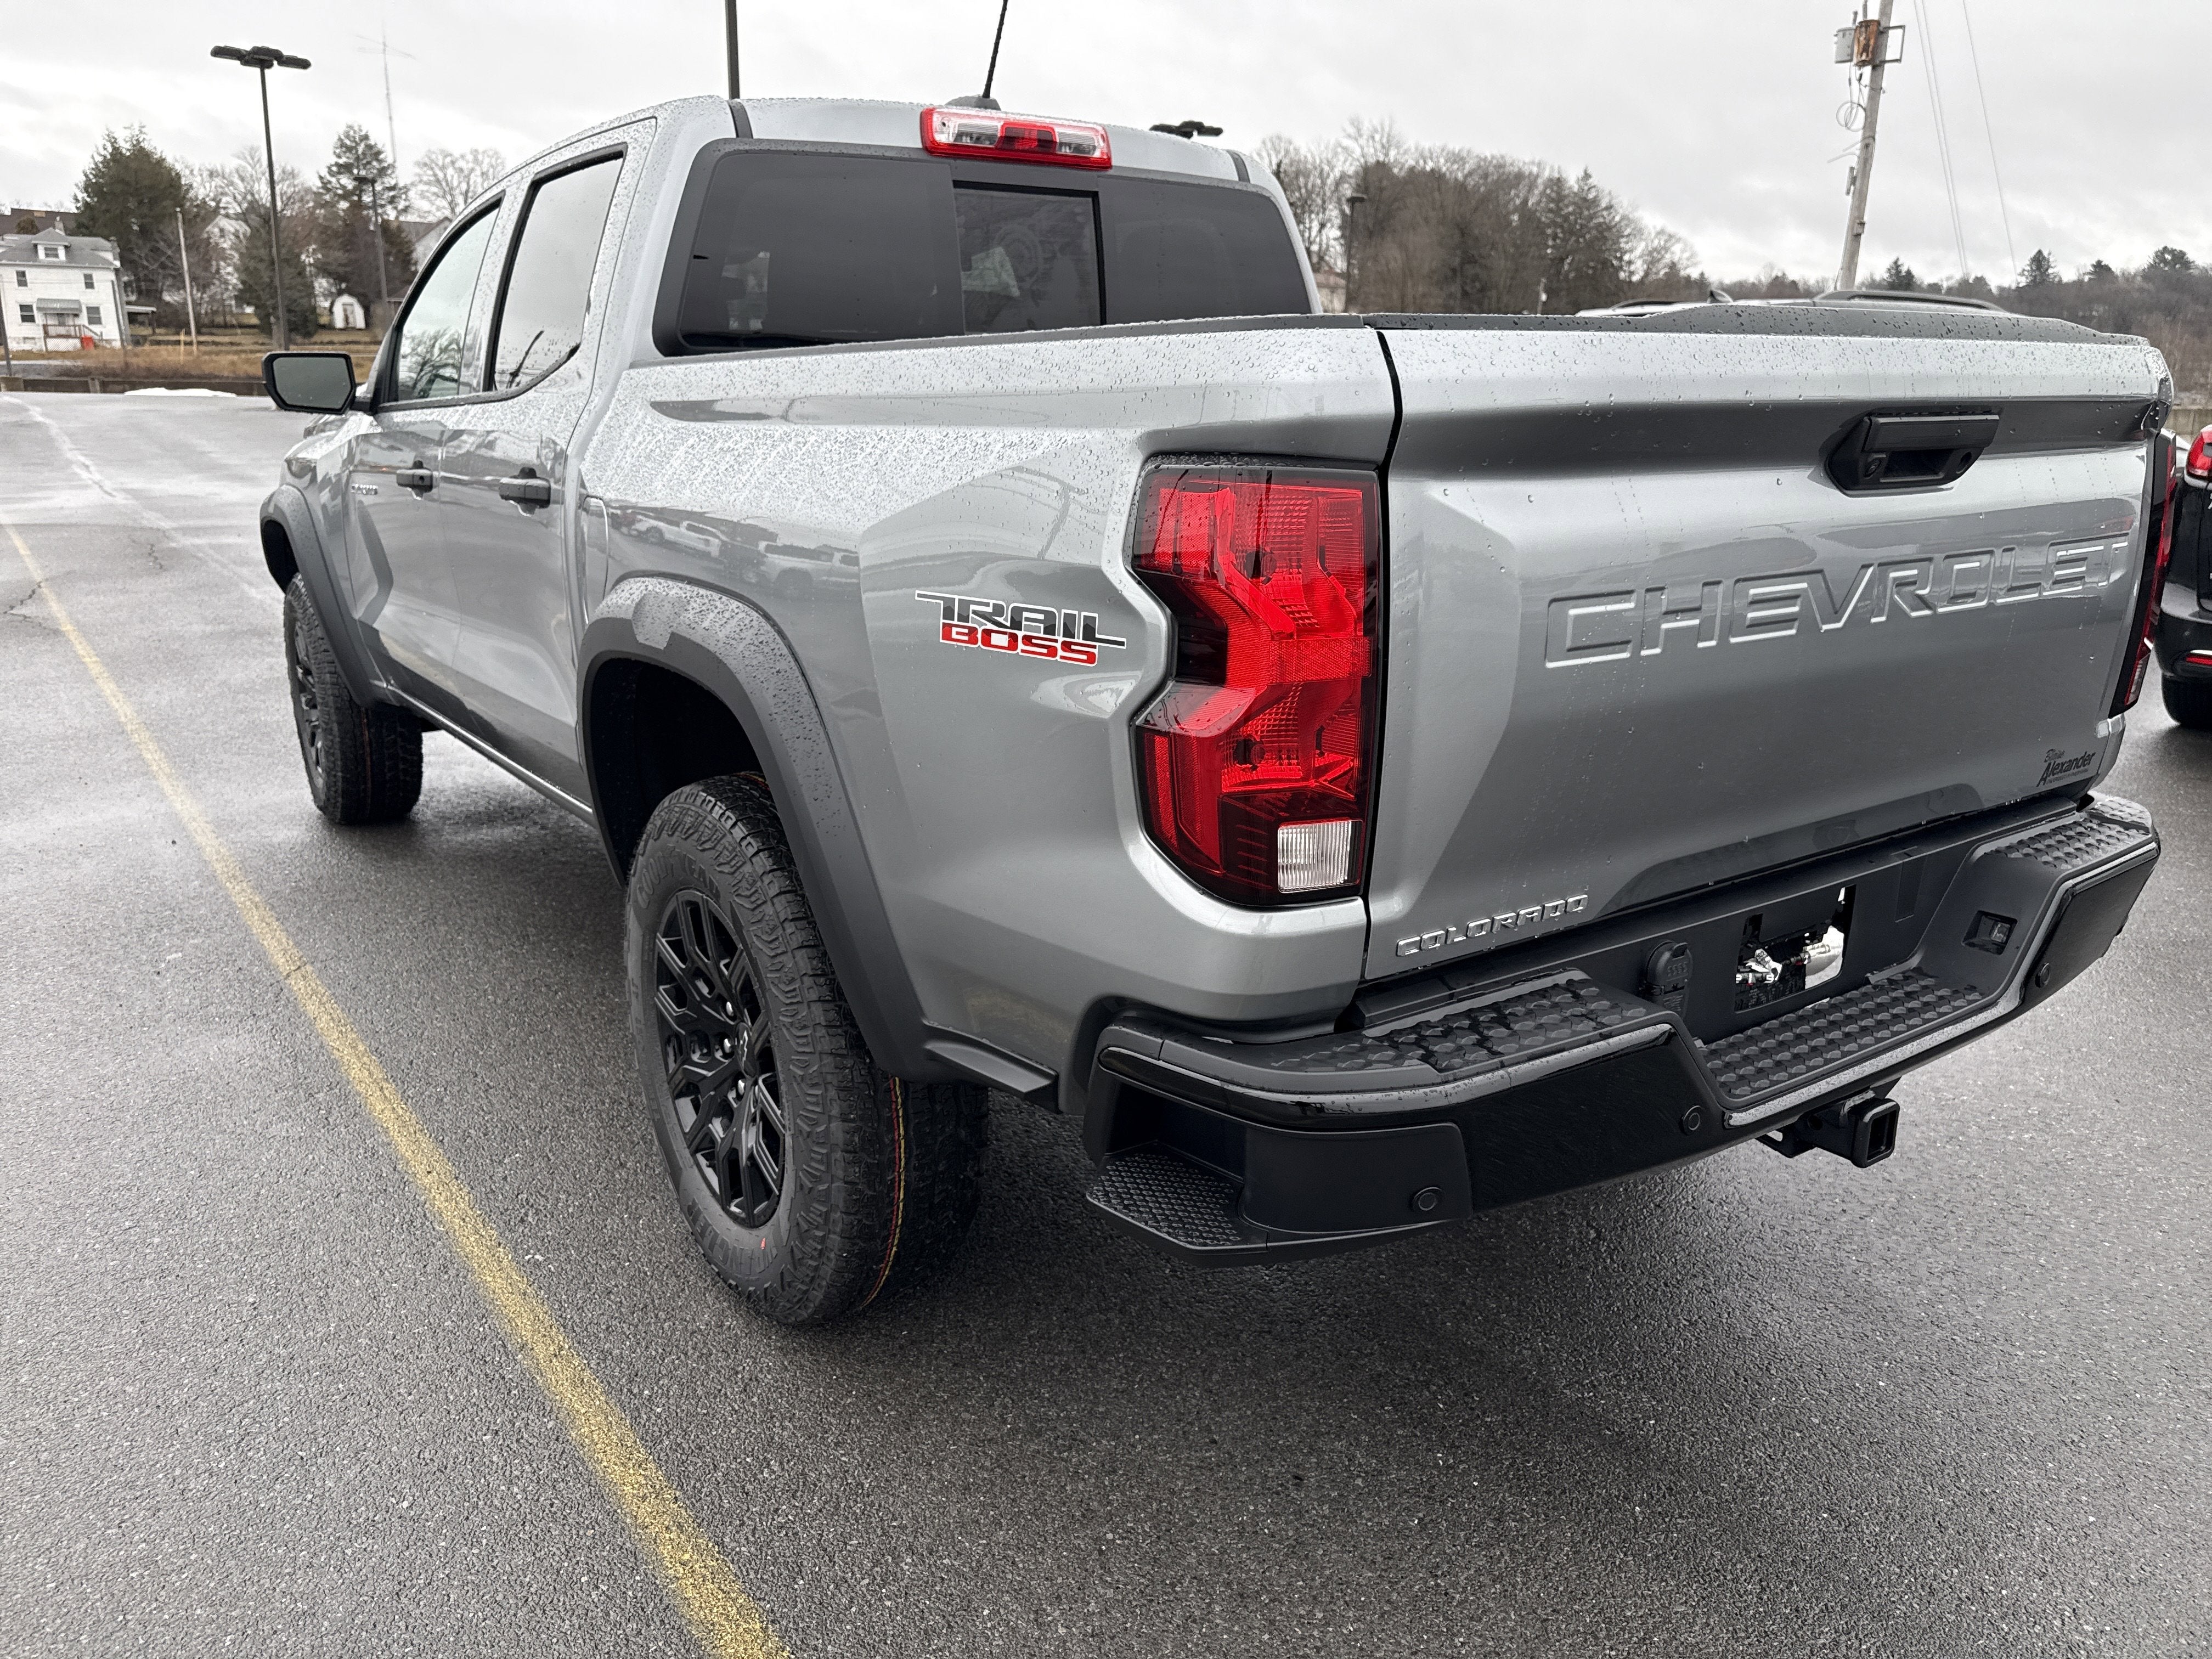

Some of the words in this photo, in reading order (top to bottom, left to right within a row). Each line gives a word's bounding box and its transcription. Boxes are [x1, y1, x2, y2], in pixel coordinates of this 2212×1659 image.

[915, 590, 1127, 649] TRAIL
[1544, 530, 2130, 670] CHEVROLET
[940, 622, 1098, 667] BOSS
[2036, 751, 2096, 787] Alexander
[1396, 894, 1588, 956] COLORADO
